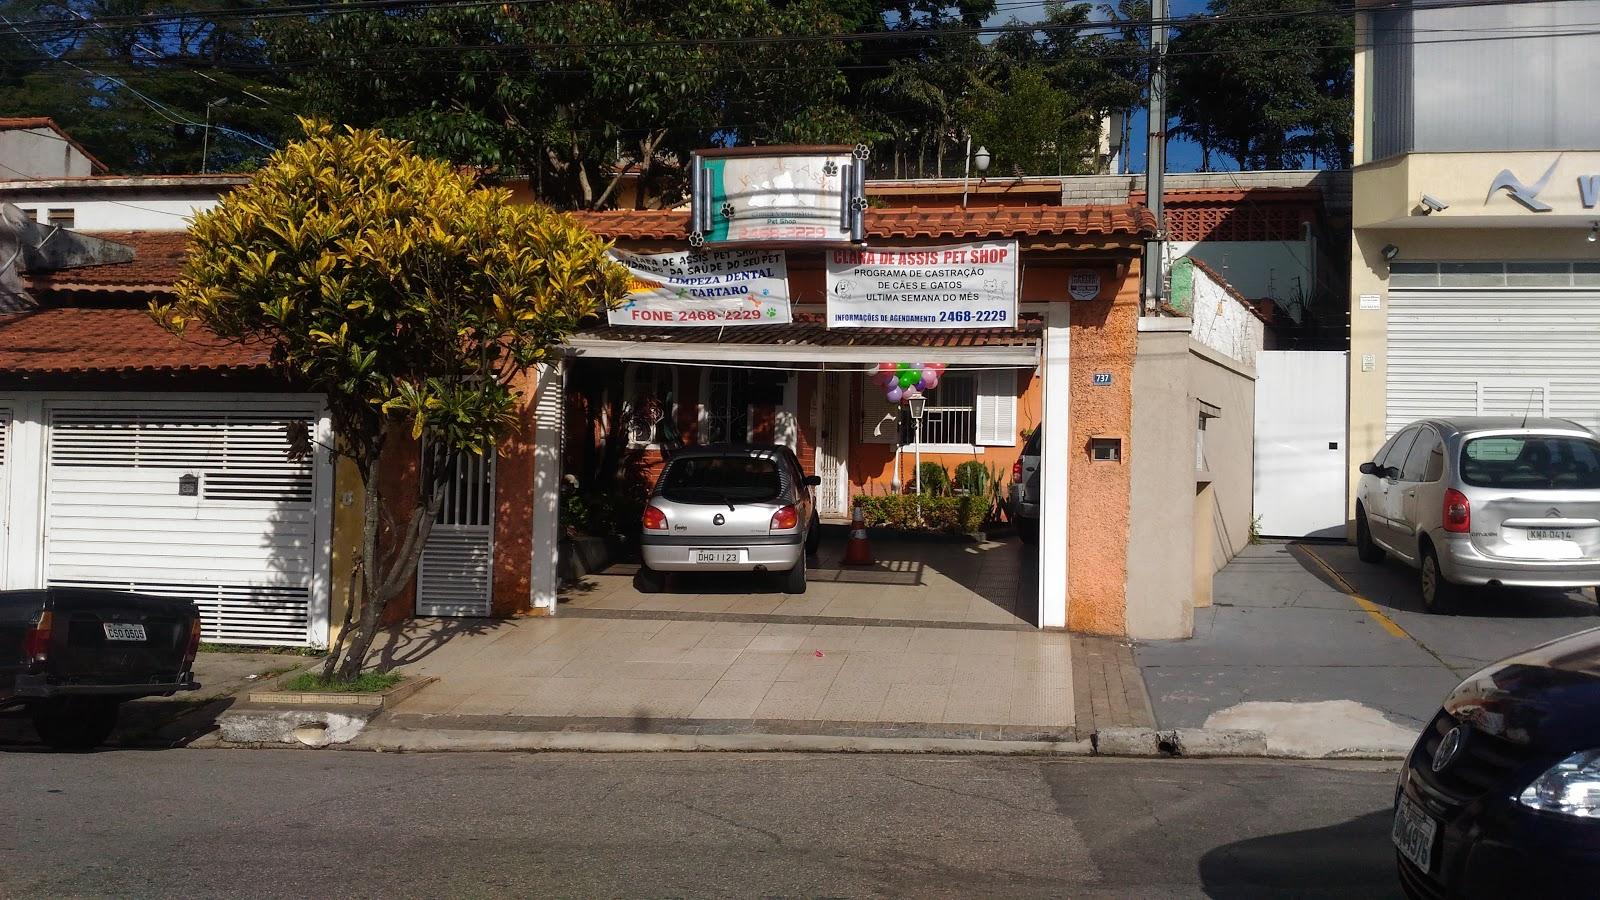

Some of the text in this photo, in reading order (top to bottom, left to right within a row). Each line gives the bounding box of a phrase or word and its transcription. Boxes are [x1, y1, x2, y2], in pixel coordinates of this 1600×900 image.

[662, 258, 675, 267] DE
[679, 252, 708, 265] ASSIS
[714, 251, 731, 262] PET
[833, 248, 1008, 266] CLARA DE ASSIS PET SHOP
[670, 267, 683, 275] DA
[728, 260, 740, 271] DO
[743, 256, 760, 267] SEU
[762, 254, 781, 265] PET
[667, 268, 774, 285] LIMPEZA DENTAL
[854, 267, 985, 278] PROGRAMA DE CASTRAÇÃO
[878, 280, 962, 290] DE CÃES E GATOS
[901, 293, 942, 302] SEMANA
[944, 293, 957, 302] DO
[959, 291, 979, 301] MÊS
[631, 309, 761, 322] FONE 2468-2229
[835, 310, 1007, 323] INFORMAÇÕES DE AGENDAMENTO 2468-2229
[1096, 374, 1109, 382] 737
[717, 553, 737, 562] 1123
